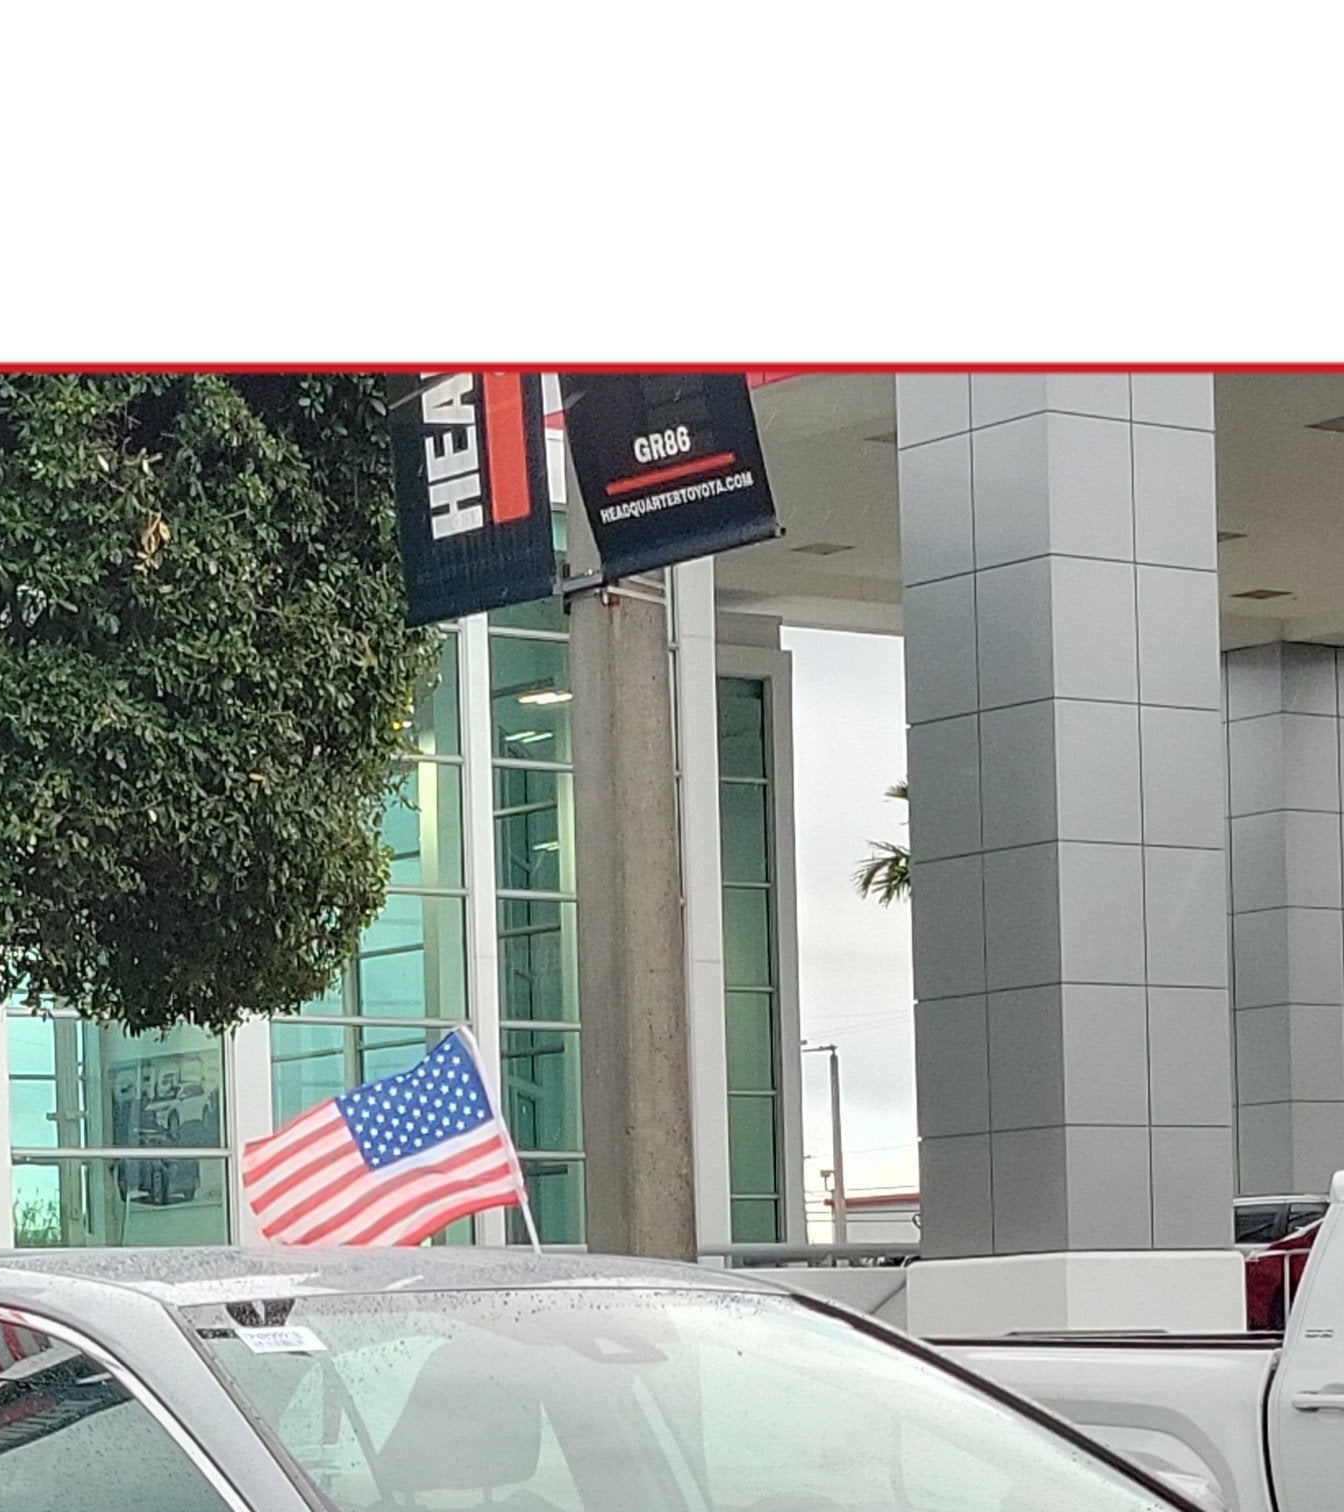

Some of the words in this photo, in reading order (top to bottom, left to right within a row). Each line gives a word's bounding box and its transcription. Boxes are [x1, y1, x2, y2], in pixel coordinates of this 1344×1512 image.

[420, 372, 484, 540] HEA
[633, 425, 692, 464] GR86
[599, 470, 755, 525] HEADQUARTERTOYOTA.COM
